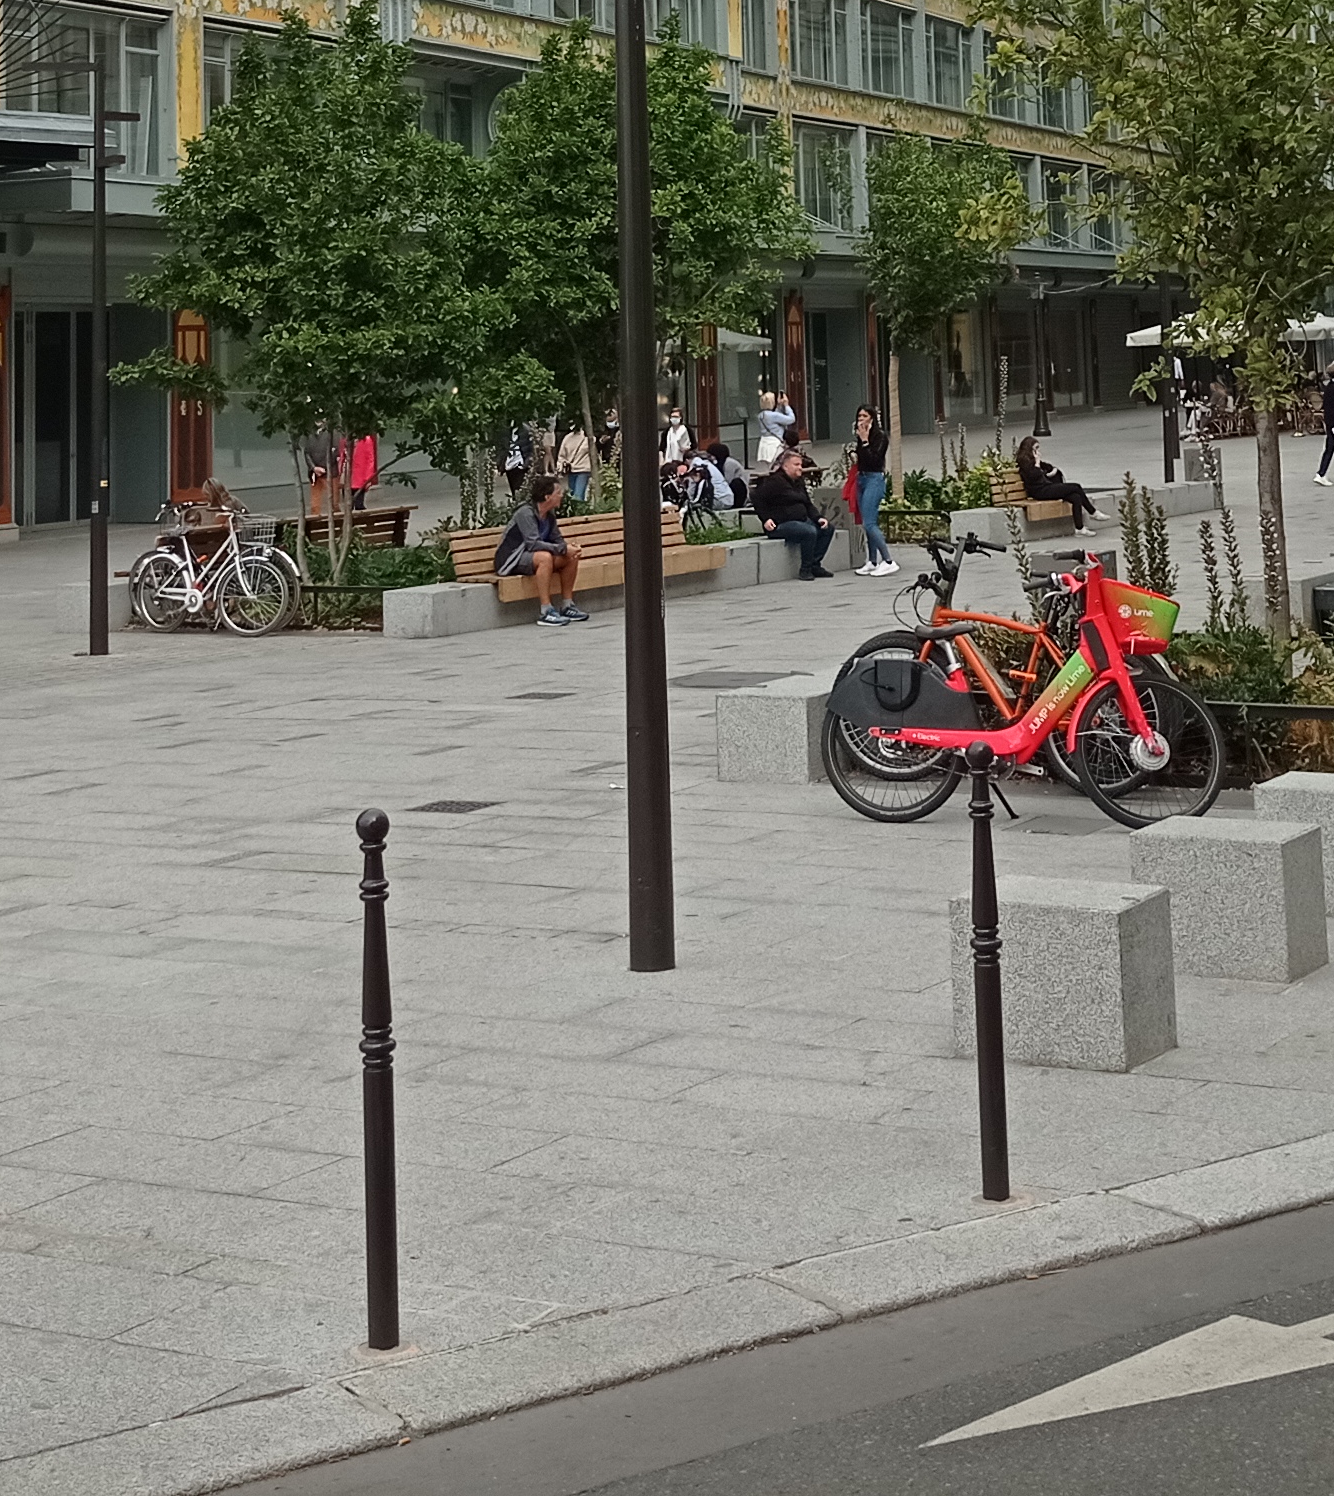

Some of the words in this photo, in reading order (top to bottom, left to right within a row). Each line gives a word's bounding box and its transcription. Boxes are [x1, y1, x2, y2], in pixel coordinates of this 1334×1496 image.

[1028, 707, 1049, 735] JUMP
[1046, 702, 1056, 712] is
[1053, 684, 1070, 705] now
[1065, 664, 1086, 687] Lime
